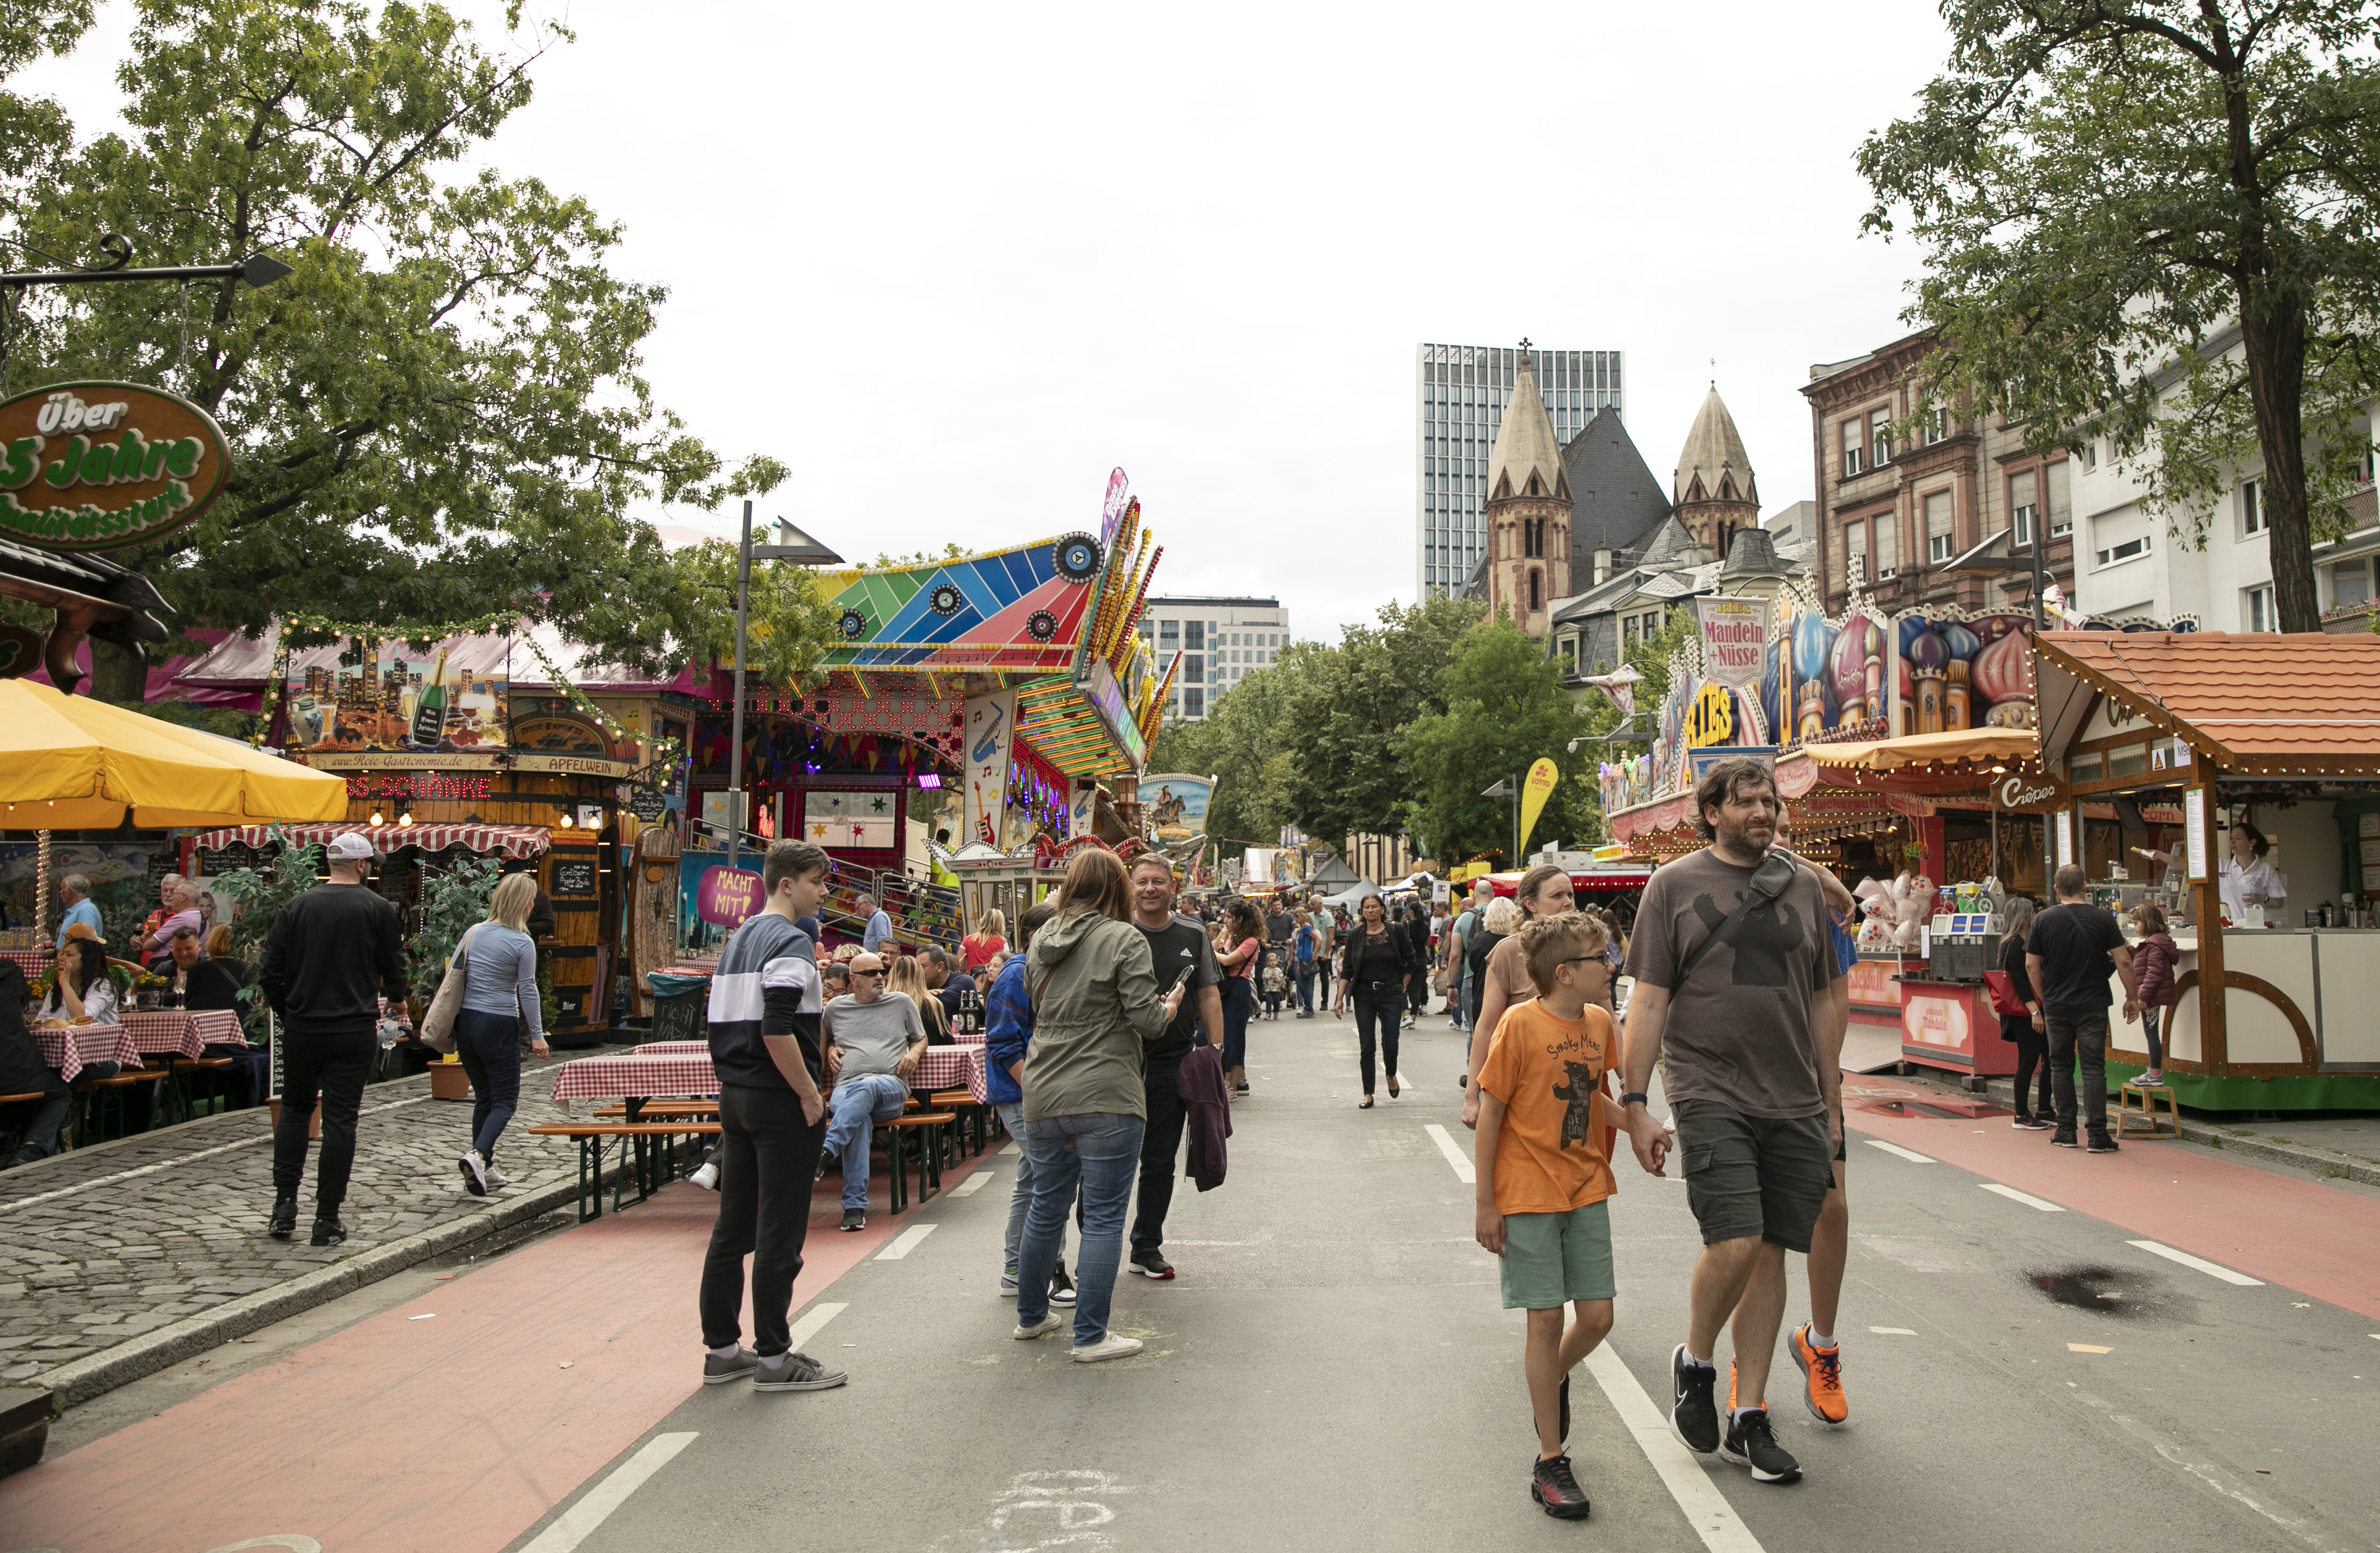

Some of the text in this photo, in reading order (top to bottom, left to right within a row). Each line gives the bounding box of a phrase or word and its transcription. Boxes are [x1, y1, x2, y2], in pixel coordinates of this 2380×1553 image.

[37, 392, 127, 435] Über
[45, 429, 201, 486] Jahre
[1716, 603, 1751, 614] RIES
[1729, 614, 1758, 623] gebrannte
[1704, 621, 1763, 643] Mandeln
[1710, 644, 1758, 666] +Nüsse
[1684, 684, 1733, 754] RIES
[521, 722, 584, 735] DISCO EXPRESS
[331, 755, 464, 768] www.Roie-Gastronomie.de
[549, 758, 611, 774] APFELWEIN
[1787, 765, 1809, 783] Popcorn
[1532, 778, 1550, 787] LOTTO
[2001, 777, 2055, 807] Crêpes
[961, 870, 976, 878] CHIPS
[1014, 868, 1029, 876] CHIPS
[1041, 868, 1055, 876] CHIPS
[717, 870, 756, 893] MACHT
[715, 893, 752, 924] MIT!
[562, 1001, 576, 1010] Bier
[1922, 1016, 1947, 1031] Mandeln
[1547, 1032, 1601, 1060] Smoky Mtns.
[1581, 1052, 1603, 1063] Tennessee
